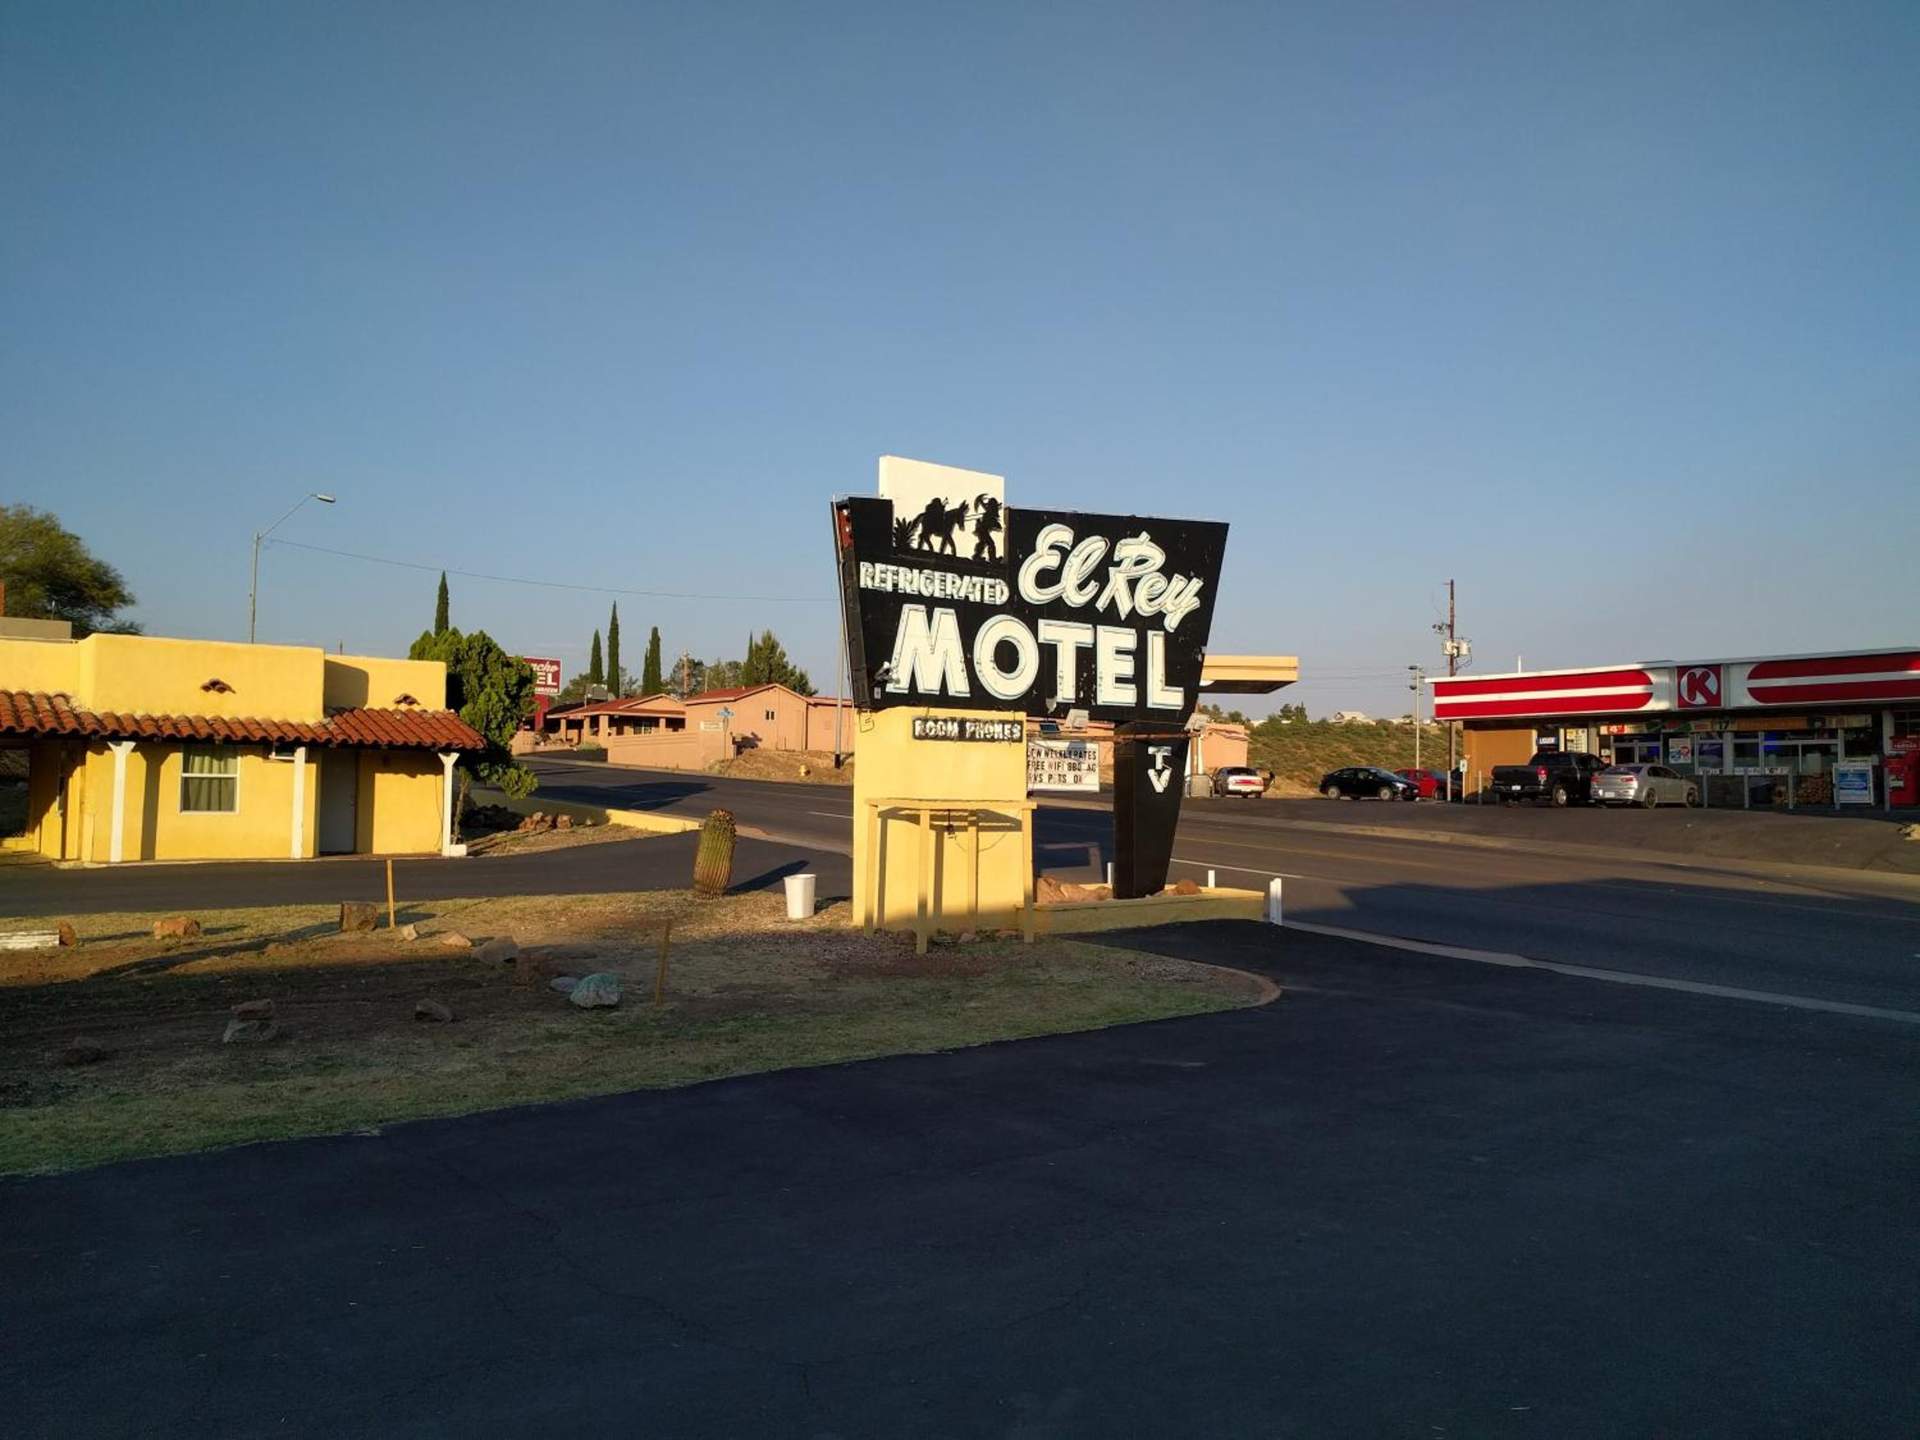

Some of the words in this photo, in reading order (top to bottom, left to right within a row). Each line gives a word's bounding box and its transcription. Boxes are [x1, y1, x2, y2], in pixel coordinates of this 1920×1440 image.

[859, 561, 1010, 606] REFRIGERATED
[1018, 523, 1110, 608] El
[1095, 531, 1204, 633] Rey
[885, 603, 1185, 710] MOTEL
[914, 719, 959, 737] ROOM
[965, 721, 1021, 740] PHONES
[1048, 774, 1067, 784] PTS
